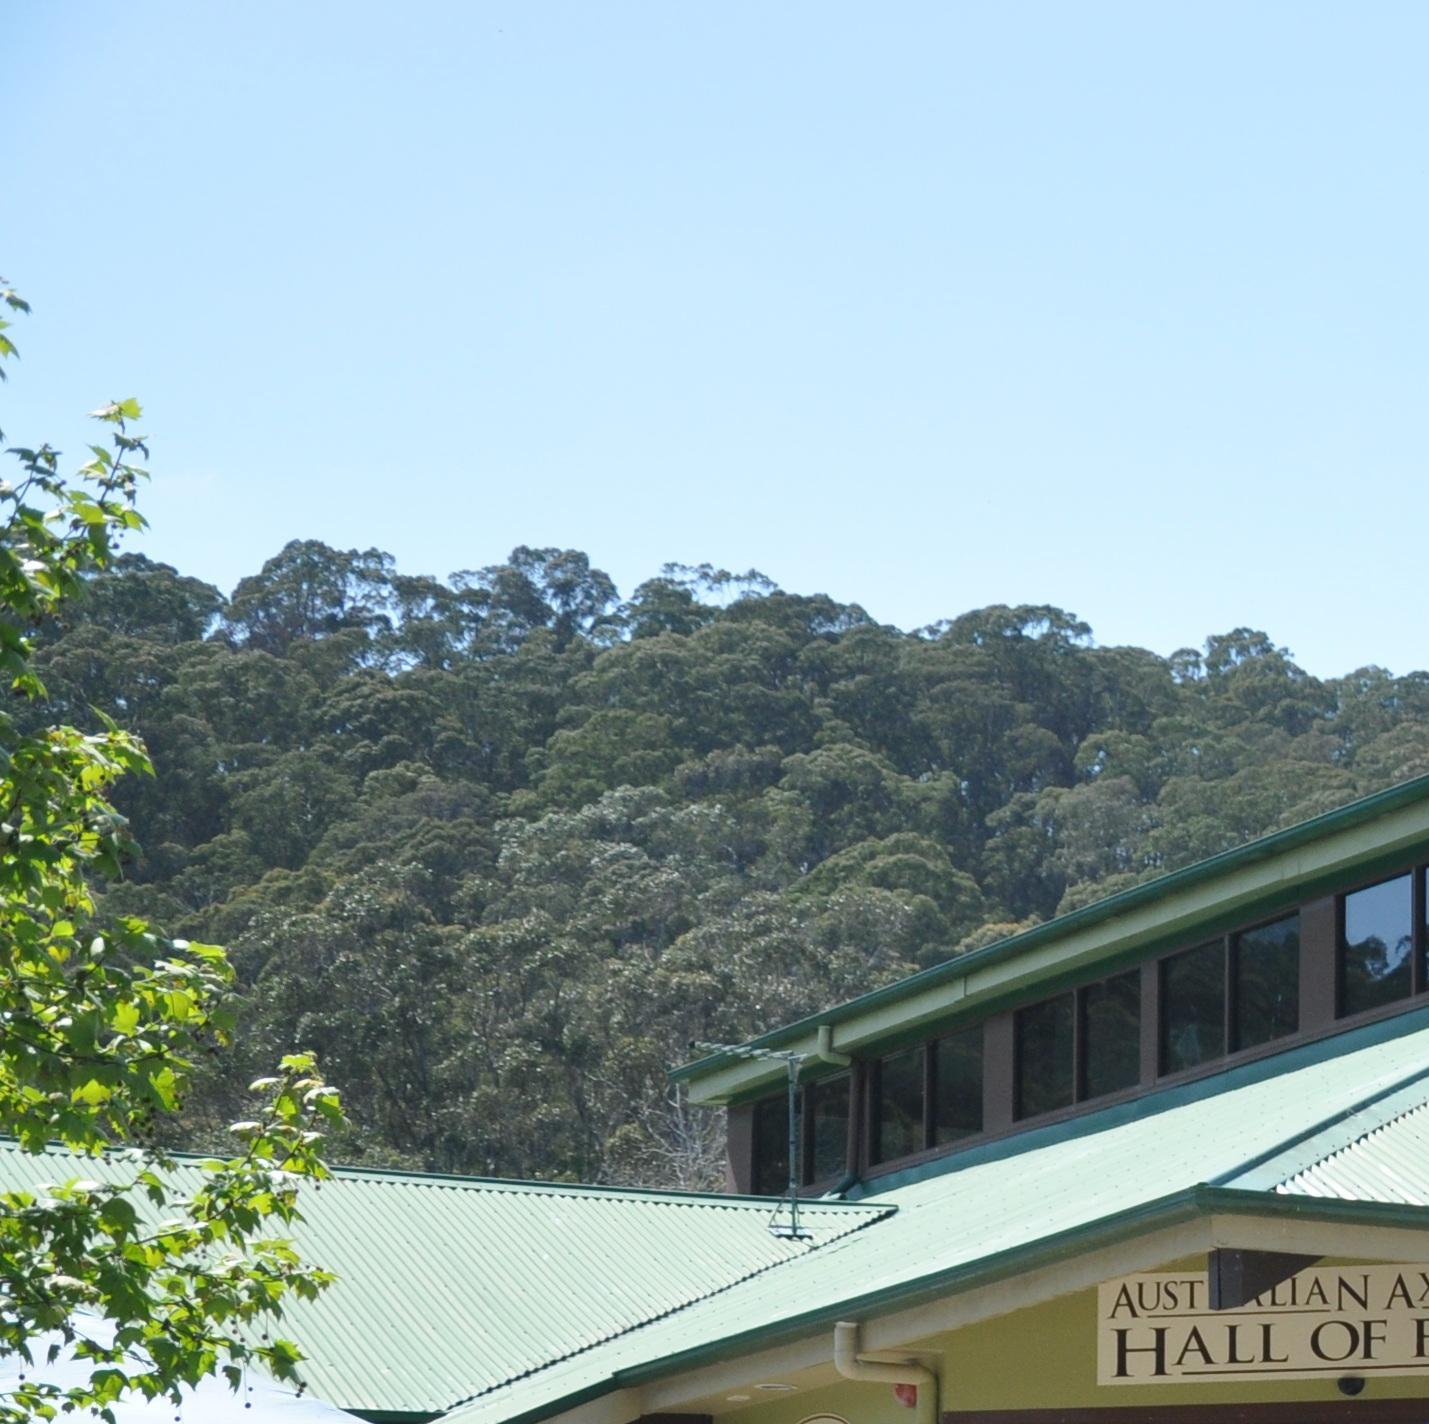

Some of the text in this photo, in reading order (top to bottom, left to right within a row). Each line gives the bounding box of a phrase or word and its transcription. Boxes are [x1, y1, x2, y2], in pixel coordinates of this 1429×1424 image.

[1108, 1274, 1372, 1319] AUSTLIAN
[1114, 1323, 1289, 1378] HALL
[1309, 1318, 1388, 1362] OF
